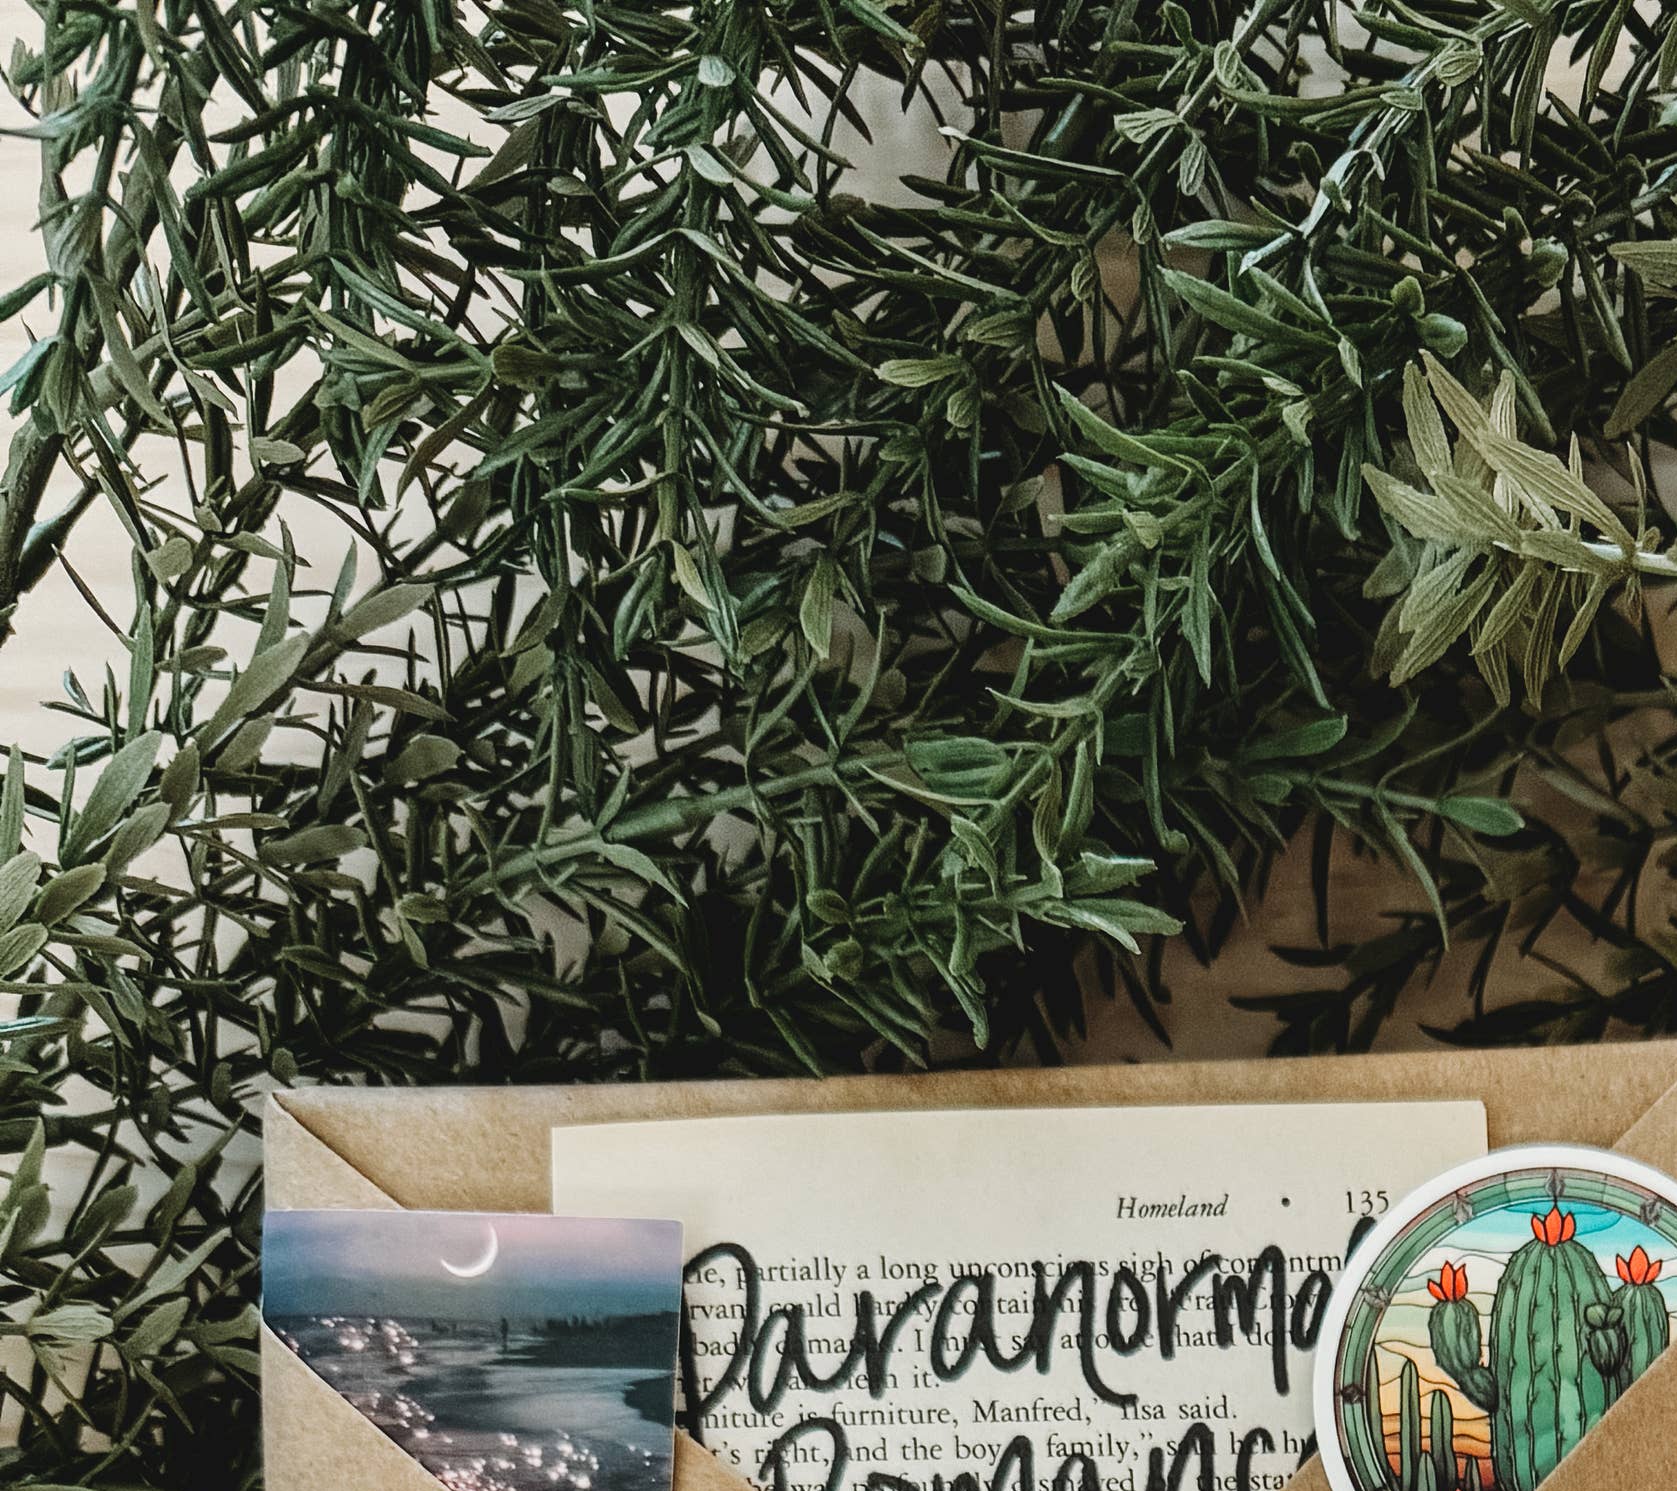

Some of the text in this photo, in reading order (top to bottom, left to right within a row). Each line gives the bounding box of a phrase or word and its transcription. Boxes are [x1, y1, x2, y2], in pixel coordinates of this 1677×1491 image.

[1116, 1190, 1389, 1219] Homeland 135
[856, 1264, 869, 1280] a
[880, 1256, 938, 1285] long
[831, 1401, 959, 1430] furniture,
[1178, 1397, 1238, 1420] said.
[901, 1437, 943, 1461] the
